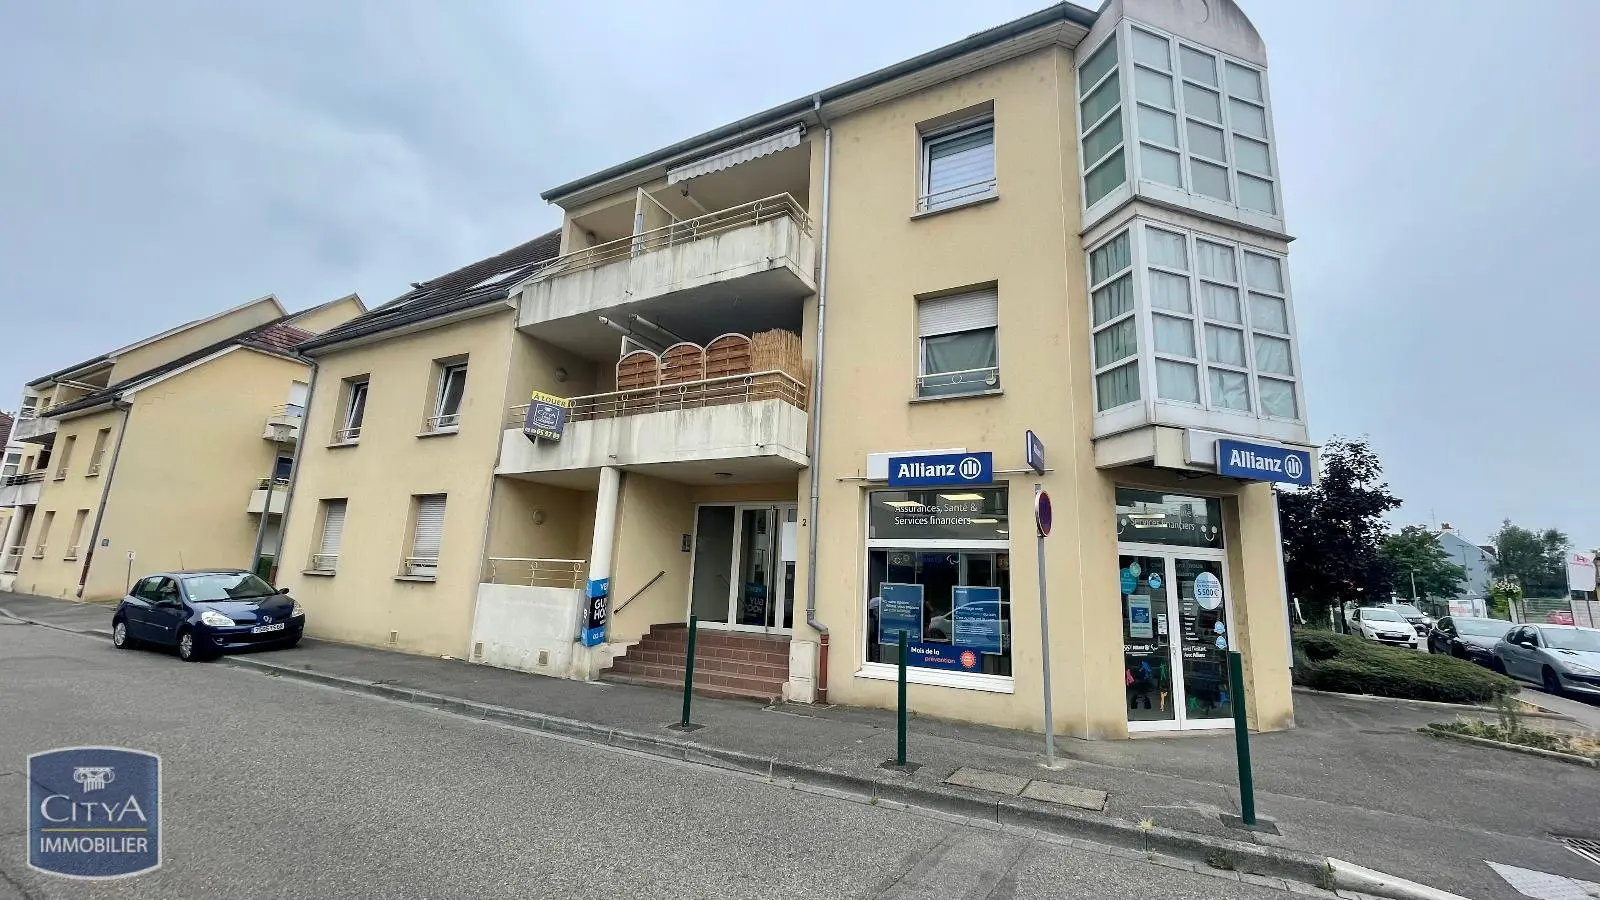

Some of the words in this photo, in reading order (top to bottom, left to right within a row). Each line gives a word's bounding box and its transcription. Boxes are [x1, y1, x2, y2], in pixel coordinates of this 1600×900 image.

[541, 396, 566, 407] LOUER
[1230, 449, 1282, 473] Allianz
[898, 462, 956, 478] Allianz
[894, 504, 942, 514] Assurances,
[944, 503, 968, 512] Santé
[970, 503, 978, 512] &
[802, 518, 807, 526] 2
[894, 516, 928, 525] Services
[930, 515, 971, 525] financiers
[911, 646, 924, 655] Mois
[934, 648, 940, 656] la
[924, 655, 956, 664] prévention
